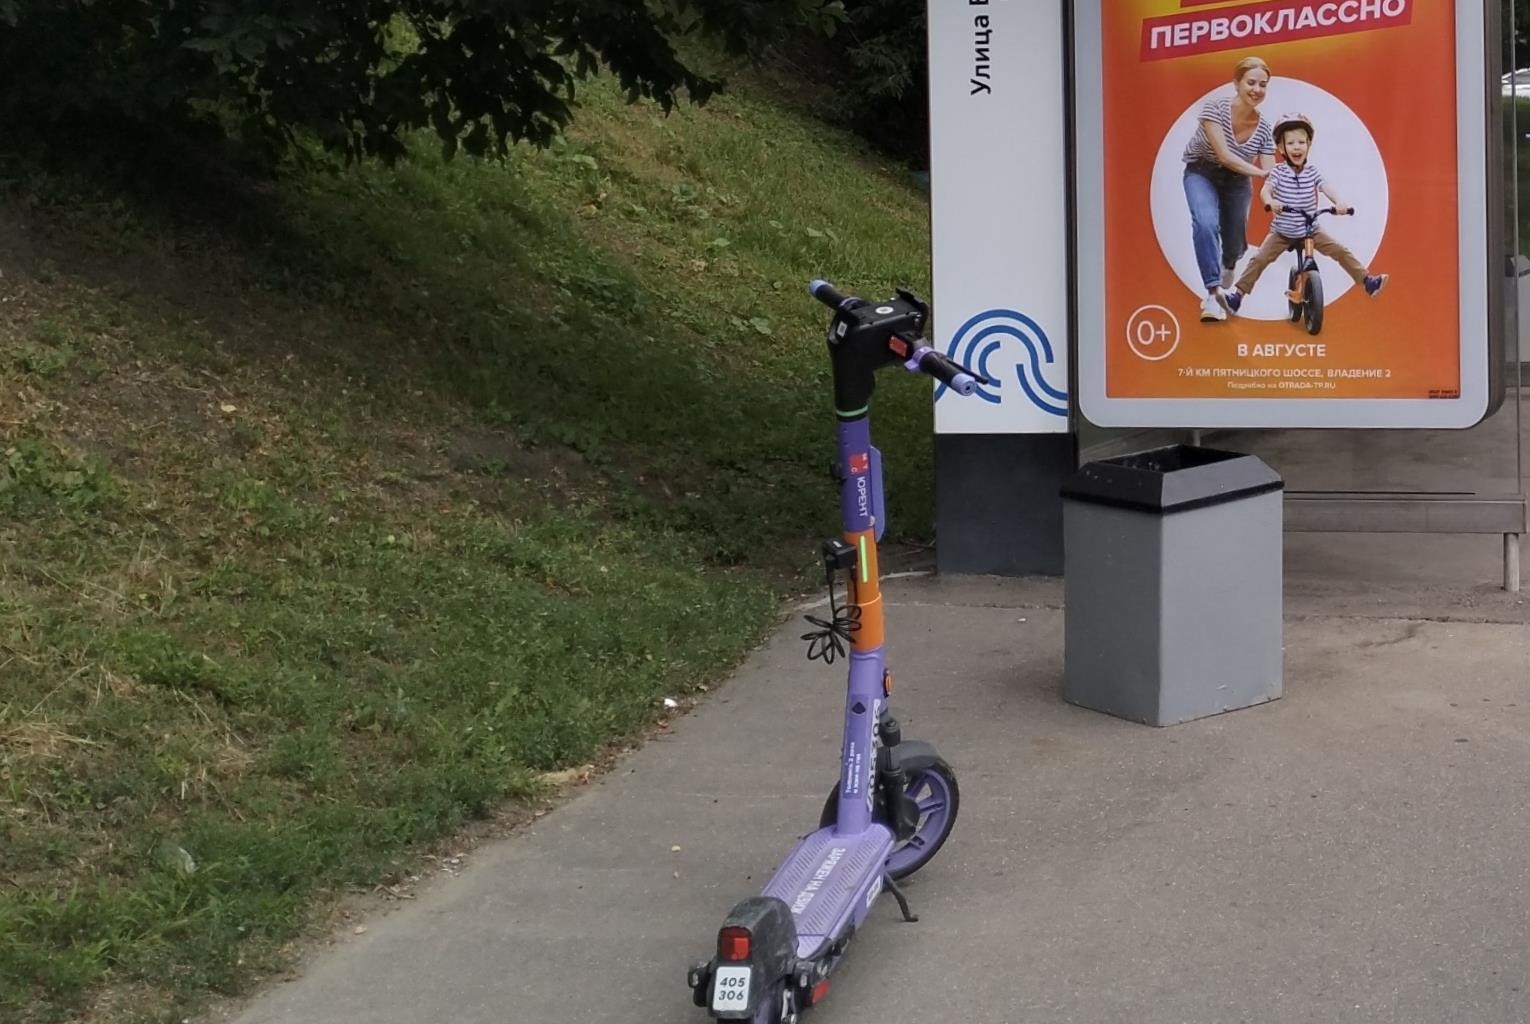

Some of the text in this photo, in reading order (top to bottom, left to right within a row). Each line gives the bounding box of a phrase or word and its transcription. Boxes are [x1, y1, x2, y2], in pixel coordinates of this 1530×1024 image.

[970, 15, 992, 96] Улица
[1137, 320, 1171, 345] 0+
[1237, 344, 1326, 357] В АВГУСТЕ
[1195, 368, 1211, 377] КМ
[1212, 368, 1281, 378] ПЯТНИЦКОГО
[1327, 369, 1383, 378] ВЛАДЕНИЕ
[1385, 369, 1392, 378] 2
[857, 476, 868, 517] ЮРЕНТ
[719, 977, 746, 988] 405
[718, 990, 744, 1001] 306
